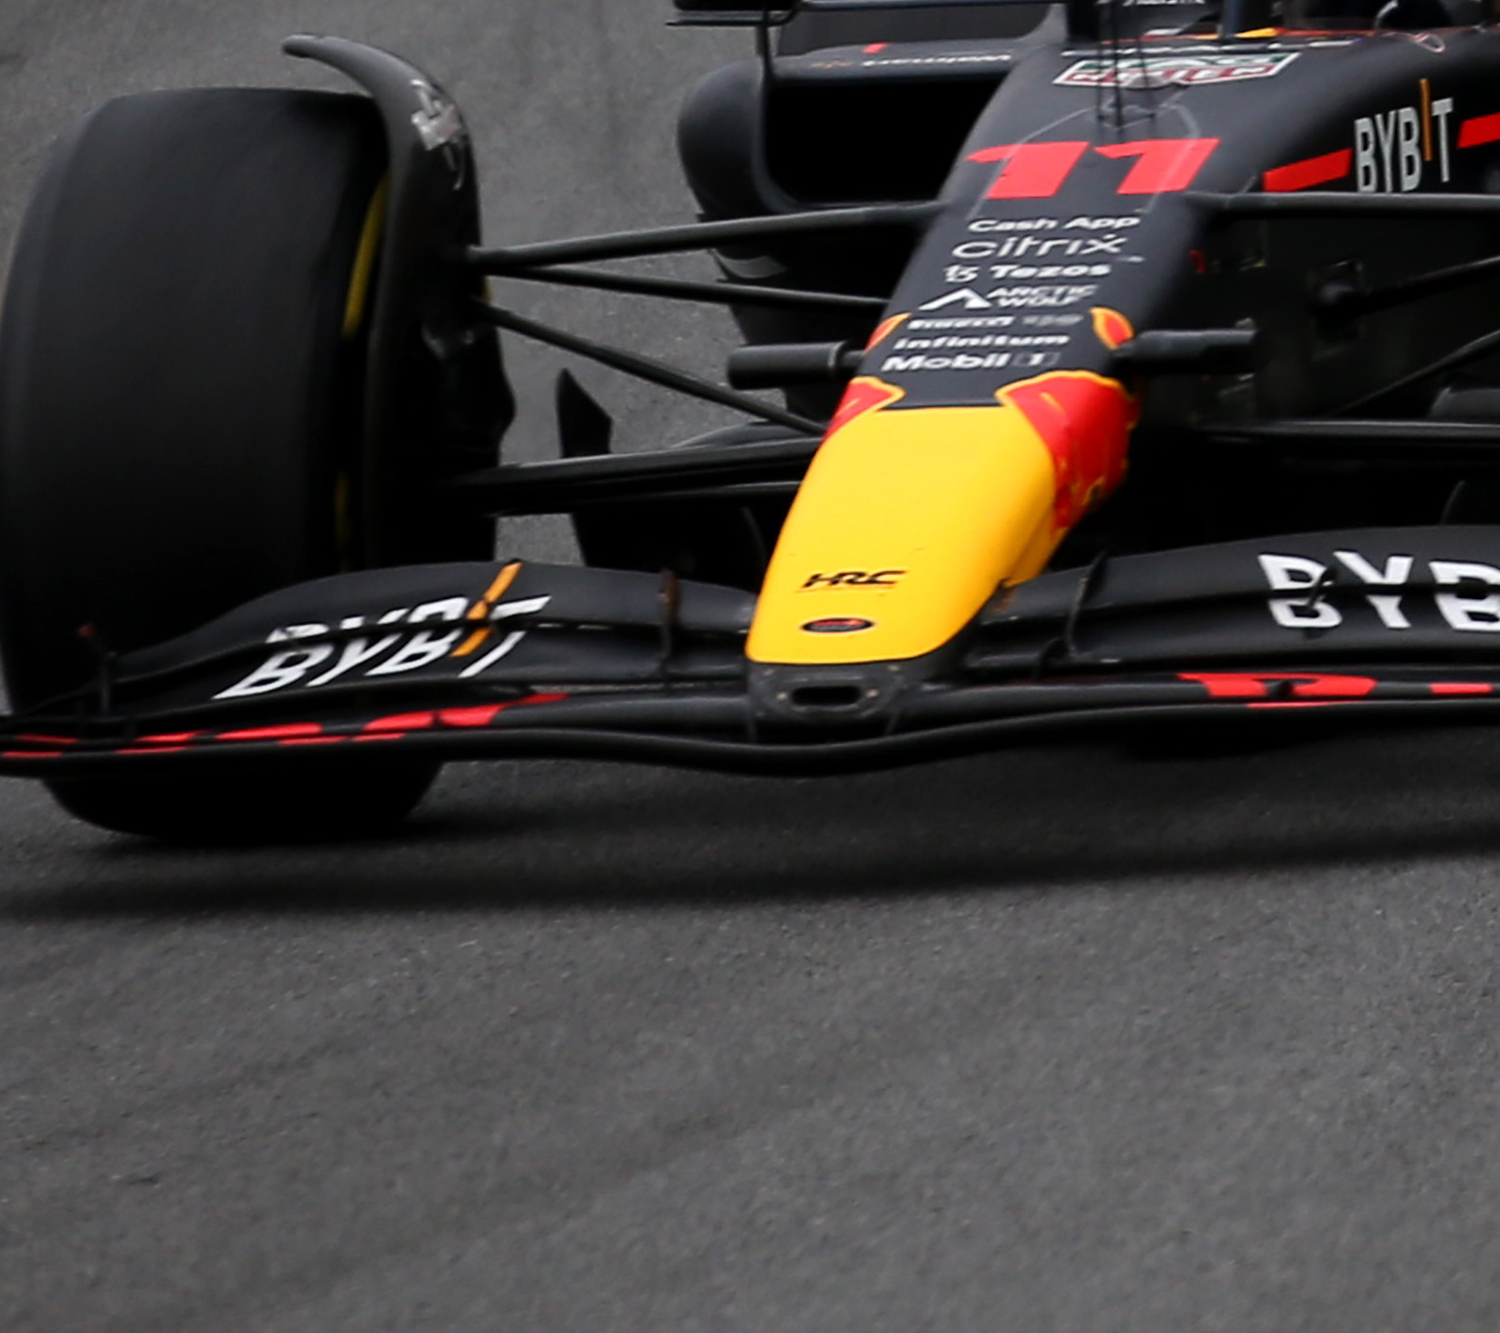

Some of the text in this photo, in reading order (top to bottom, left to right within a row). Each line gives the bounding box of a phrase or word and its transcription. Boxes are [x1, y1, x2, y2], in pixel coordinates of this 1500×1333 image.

[1354, 78, 1454, 194] BYBIT
[965, 137, 1222, 200] 11
[967, 216, 1141, 232] Cash App
[990, 263, 1112, 281] Tezos
[880, 352, 1011, 372] Mobil
[801, 569, 908, 589] HRC
[213, 562, 553, 700] BYBIT
